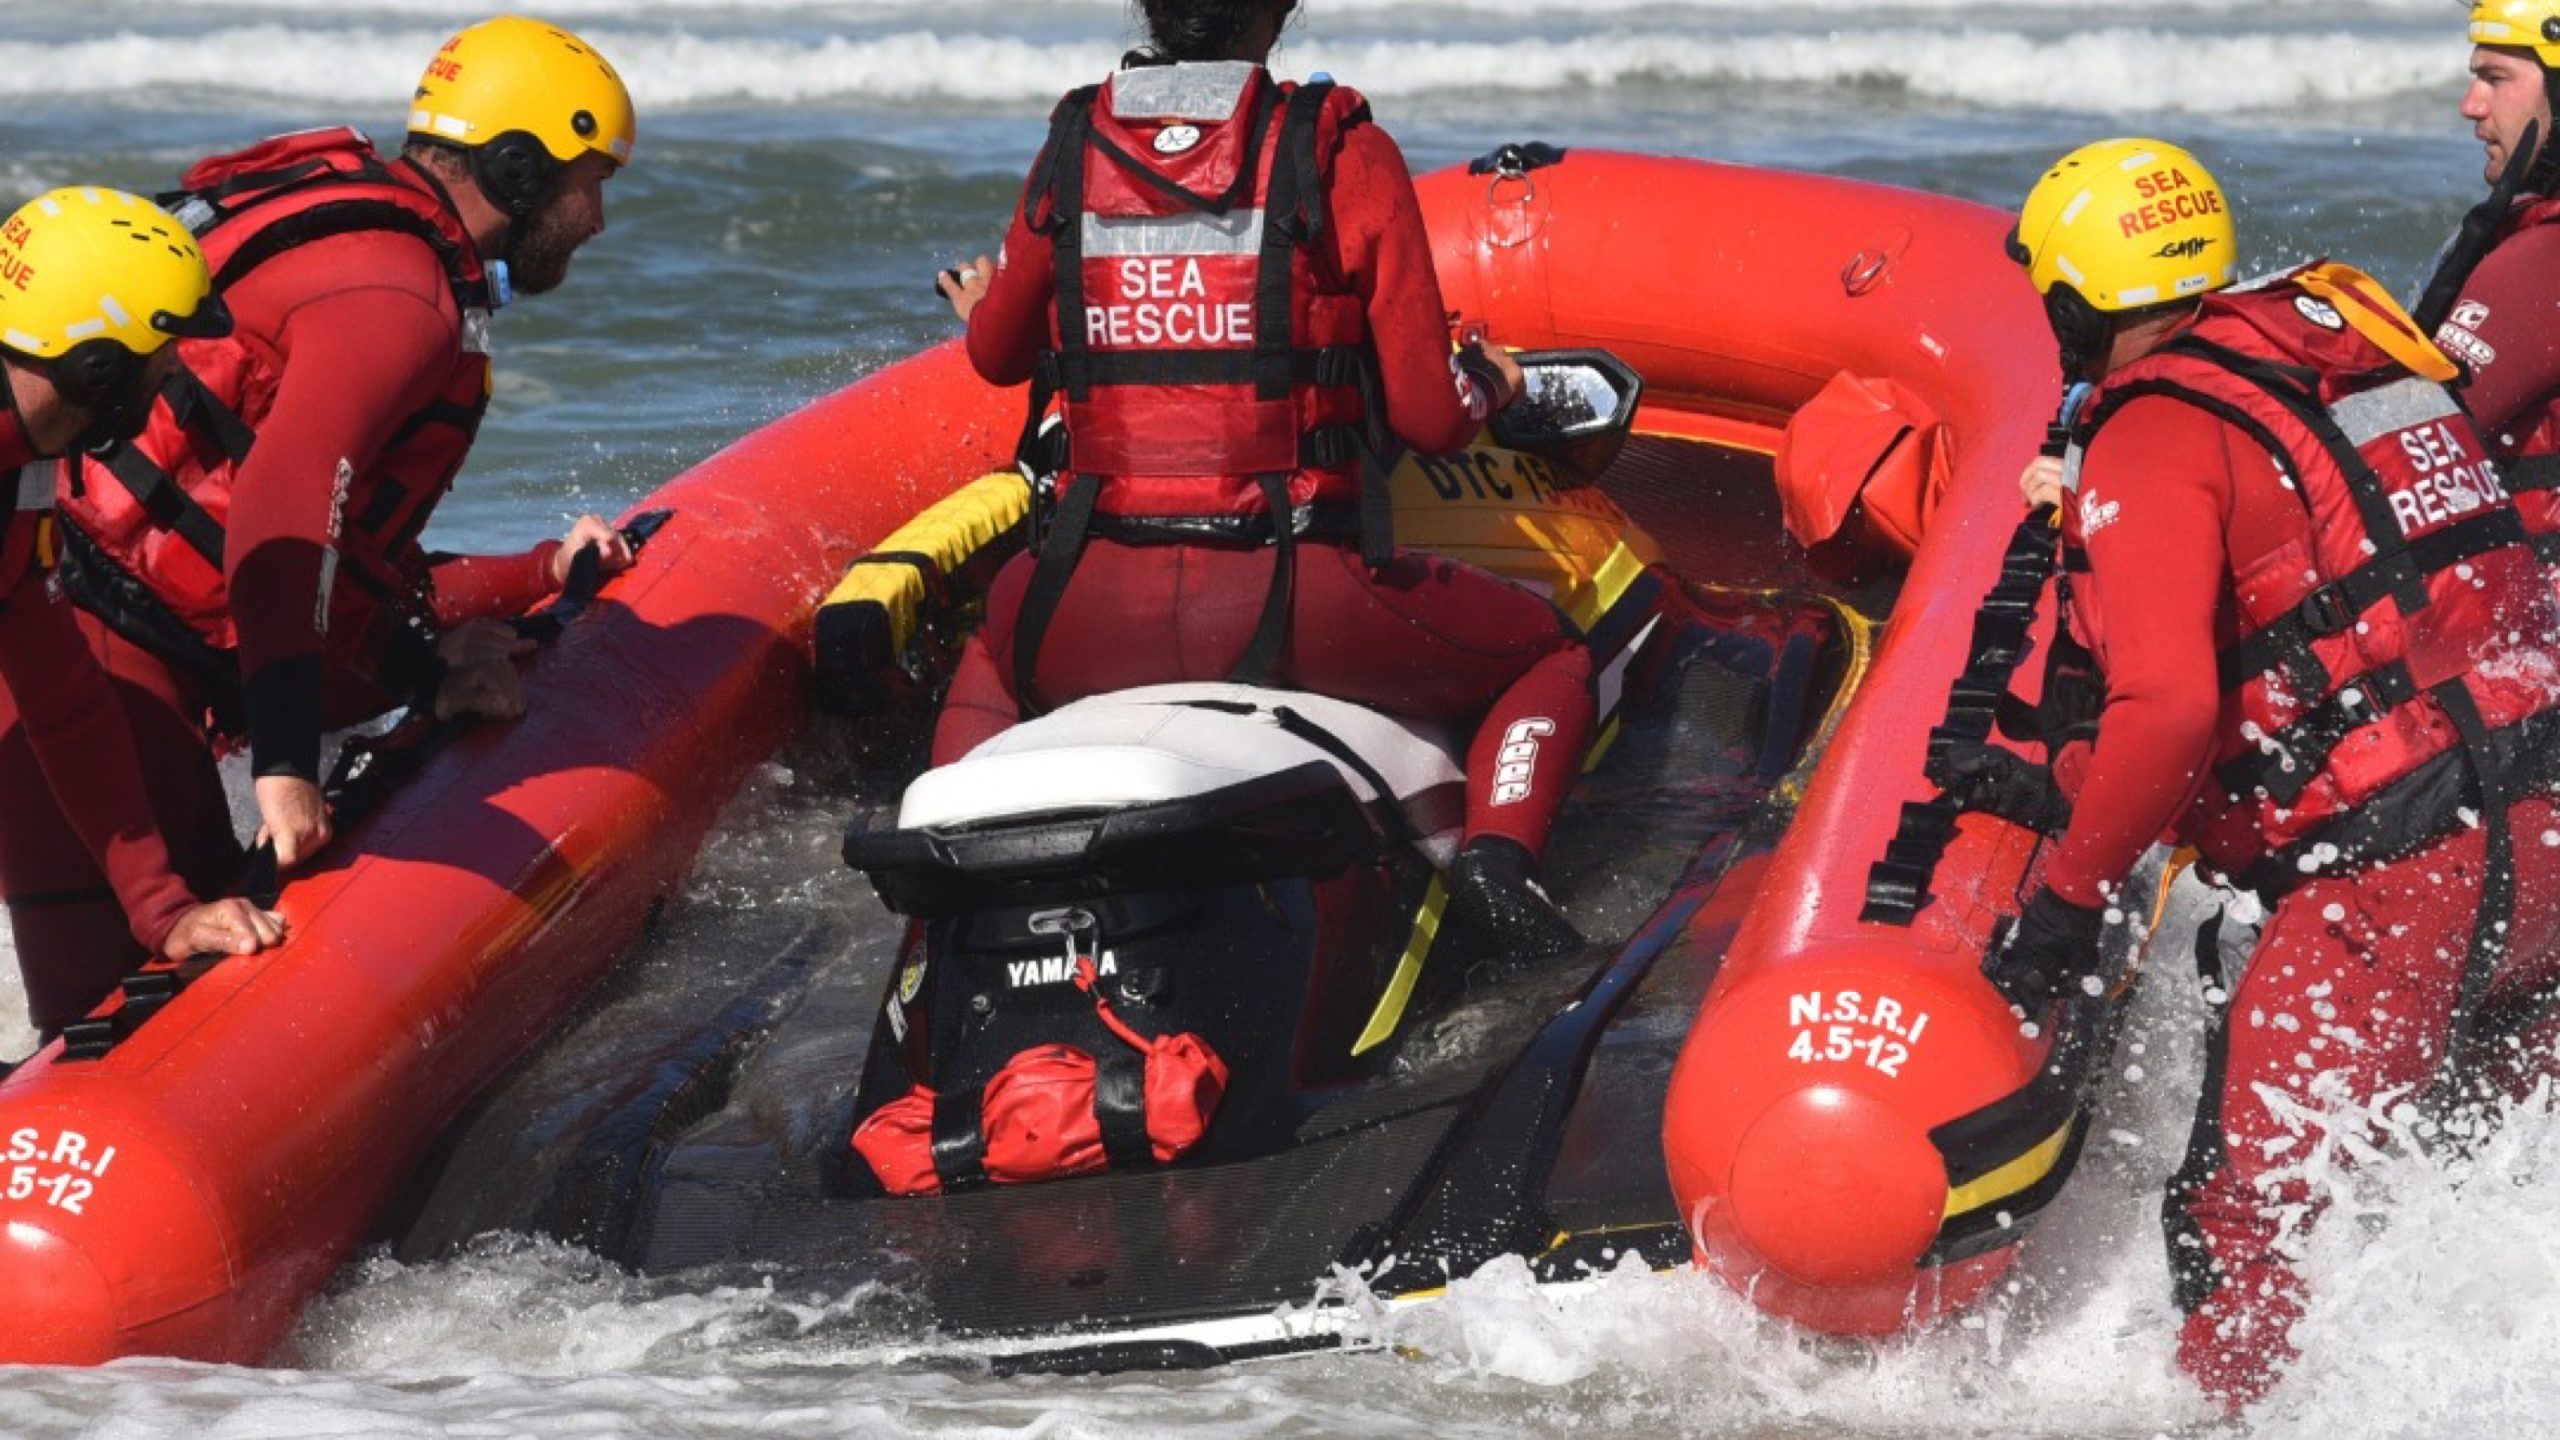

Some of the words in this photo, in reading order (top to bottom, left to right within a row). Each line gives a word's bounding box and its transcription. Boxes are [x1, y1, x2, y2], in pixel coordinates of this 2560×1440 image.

[2135, 168, 2191, 198] SEA
[2119, 190, 2222, 239] RESCUE
[1121, 258, 1205, 299] SEA
[1085, 303, 1253, 345] RESCUE
[2400, 422, 2467, 472] SEA
[1412, 451, 1514, 501] DTC
[2388, 460, 2509, 535] RESCUE
[1789, 991, 1931, 1044] N.S.R.I
[1787, 1025, 1909, 1078] 4.5-12
[0, 1127, 116, 1177] .S.R.I
